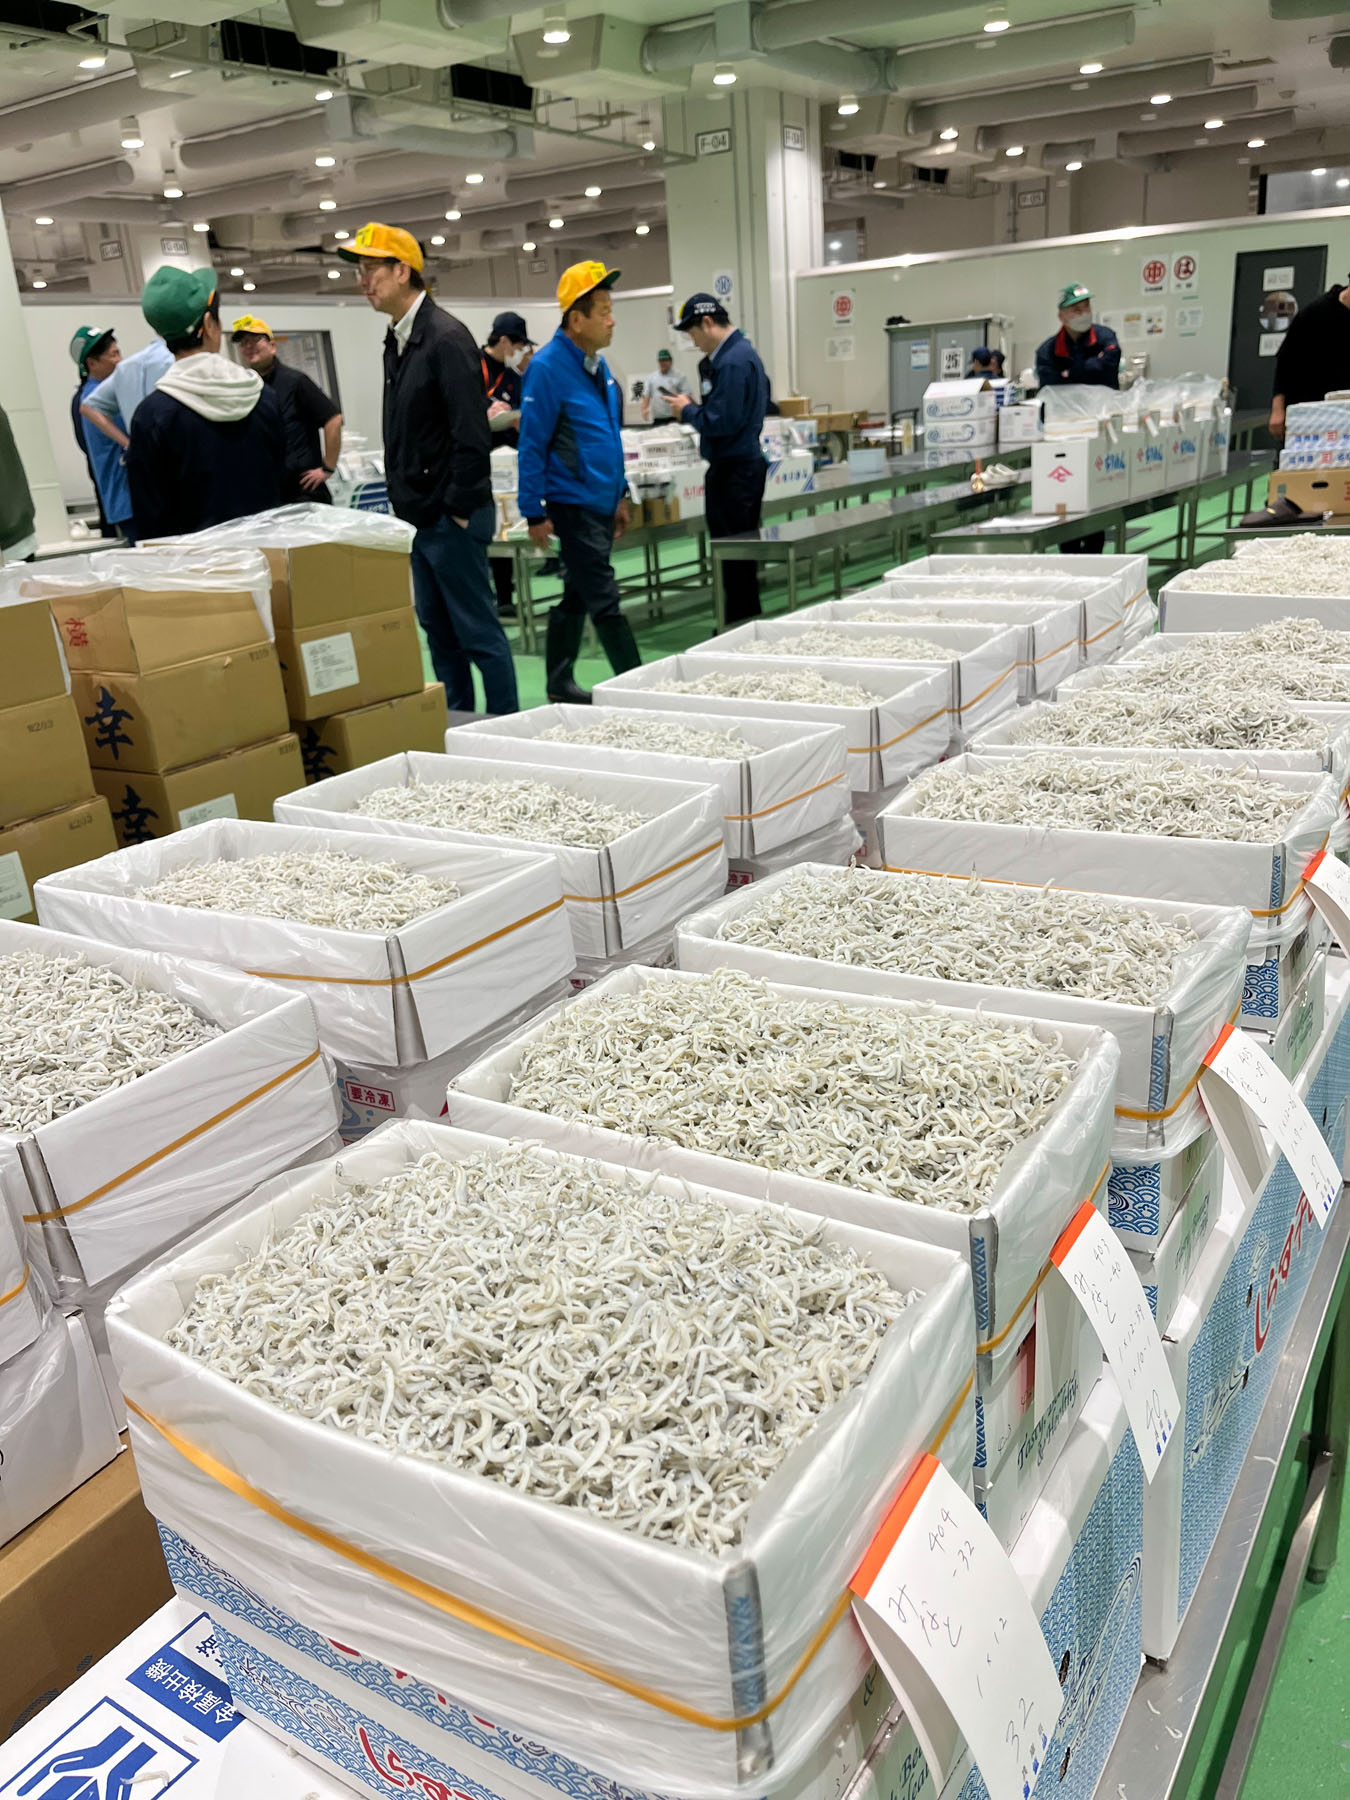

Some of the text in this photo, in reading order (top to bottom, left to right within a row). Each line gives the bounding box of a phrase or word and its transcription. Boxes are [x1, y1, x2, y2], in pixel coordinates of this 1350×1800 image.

[85, 686, 134, 761] 幸
[928, 1508, 958, 1554] 404
[888, 1584, 962, 1648] みなと
[144, 1657, 239, 1725] 金属検出機
